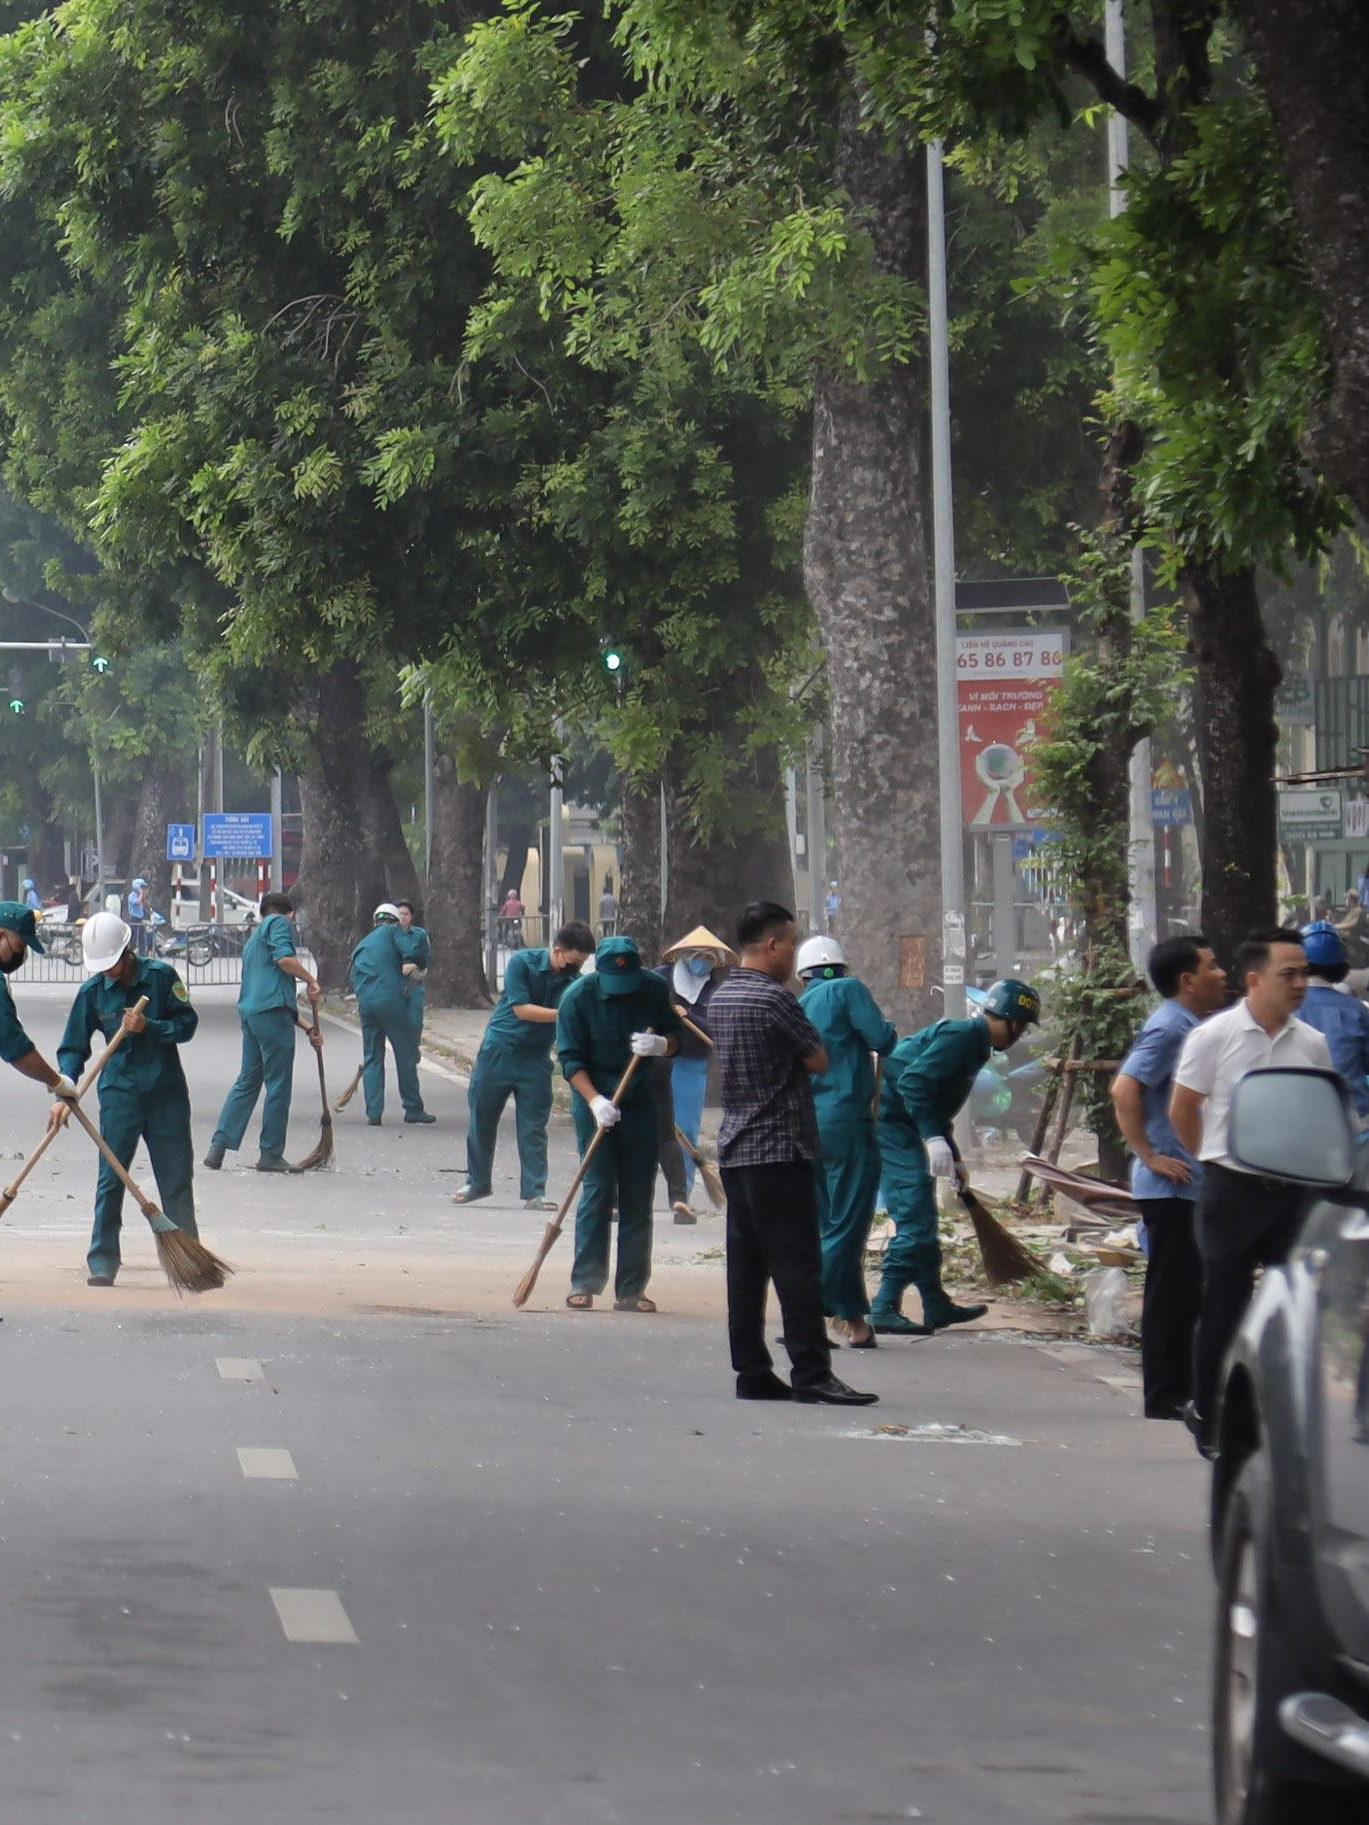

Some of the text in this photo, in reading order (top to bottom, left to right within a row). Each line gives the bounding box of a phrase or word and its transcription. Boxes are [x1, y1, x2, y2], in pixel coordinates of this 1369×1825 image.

[957, 653, 979, 668] 65
[985, 652, 1006, 667] 86
[1013, 651, 1033, 667] 87
